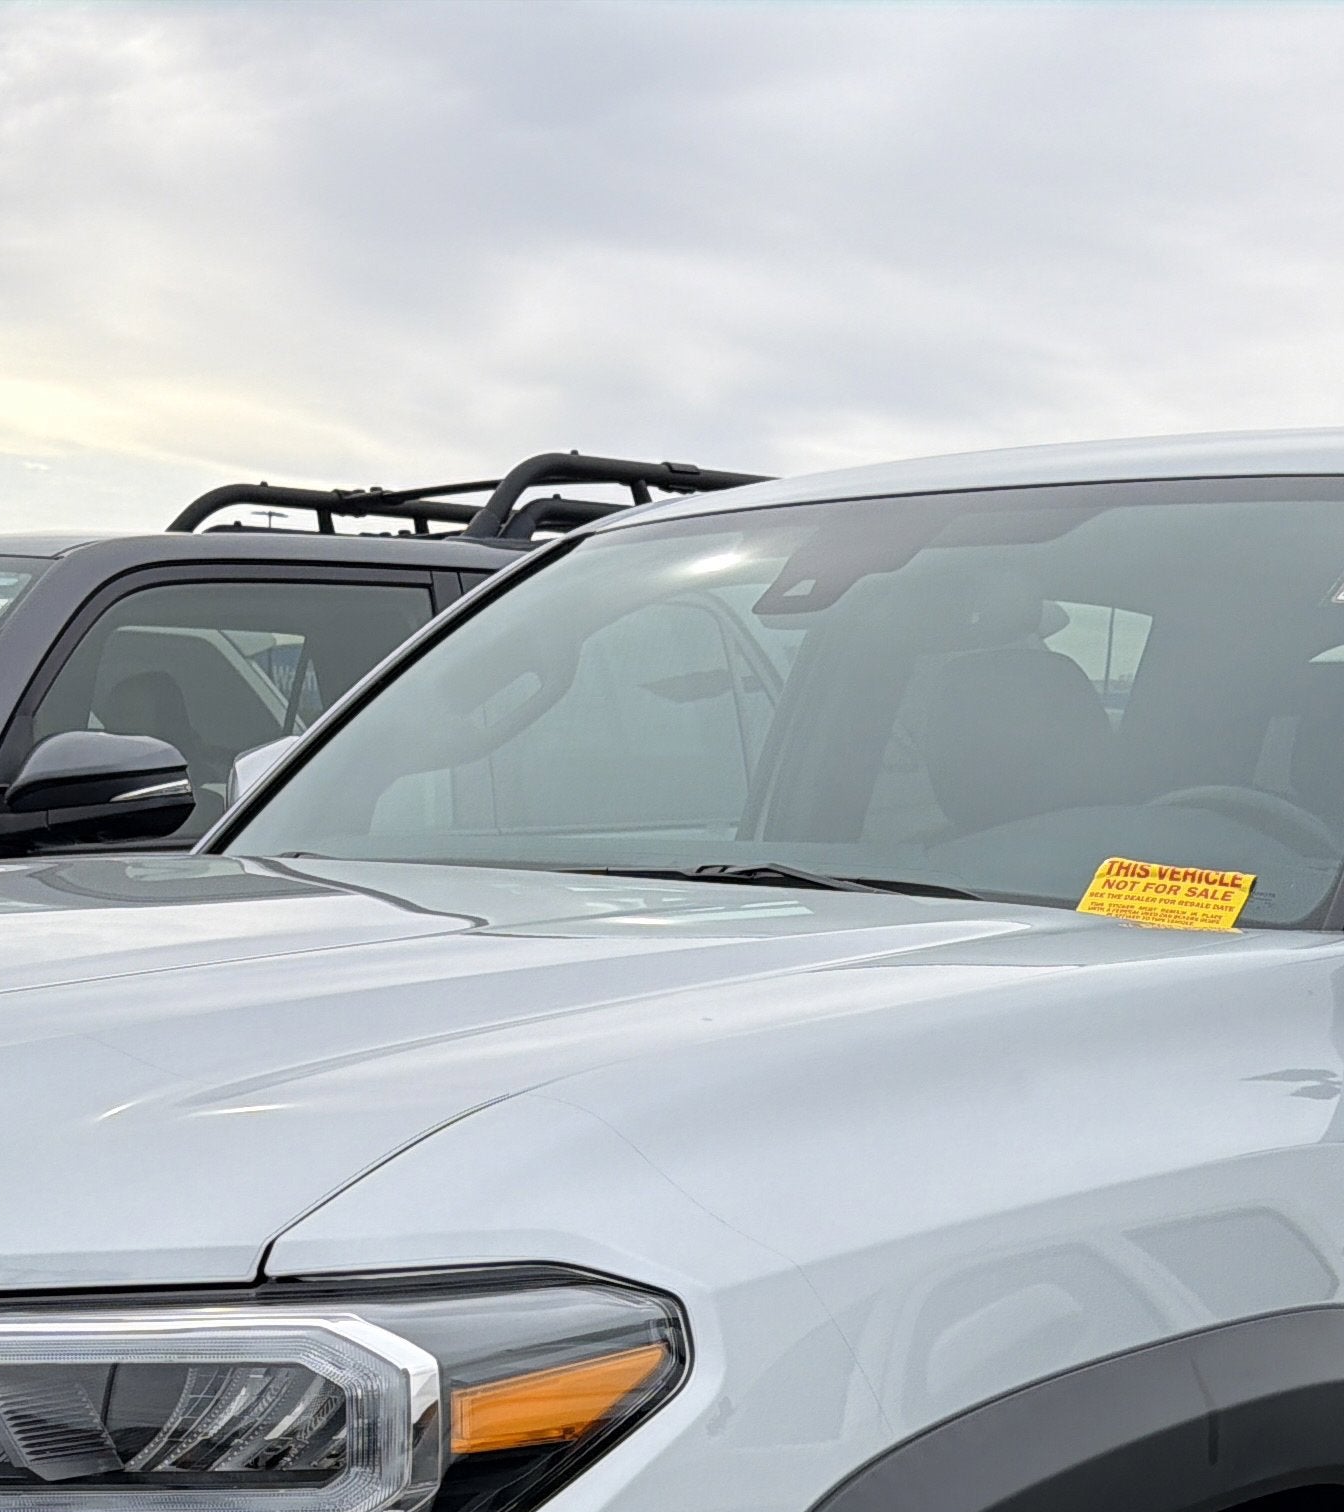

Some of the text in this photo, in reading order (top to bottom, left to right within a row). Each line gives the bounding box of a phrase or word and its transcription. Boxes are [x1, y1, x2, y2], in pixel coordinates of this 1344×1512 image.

[1105, 860, 1243, 889] THIS VEHICLE
[1101, 878, 1141, 892] NOT
[1142, 882, 1182, 896] FOR
[1184, 886, 1235, 902] SALE
[1123, 894, 1158, 903] DEALER
[1158, 897, 1177, 905] FOR
